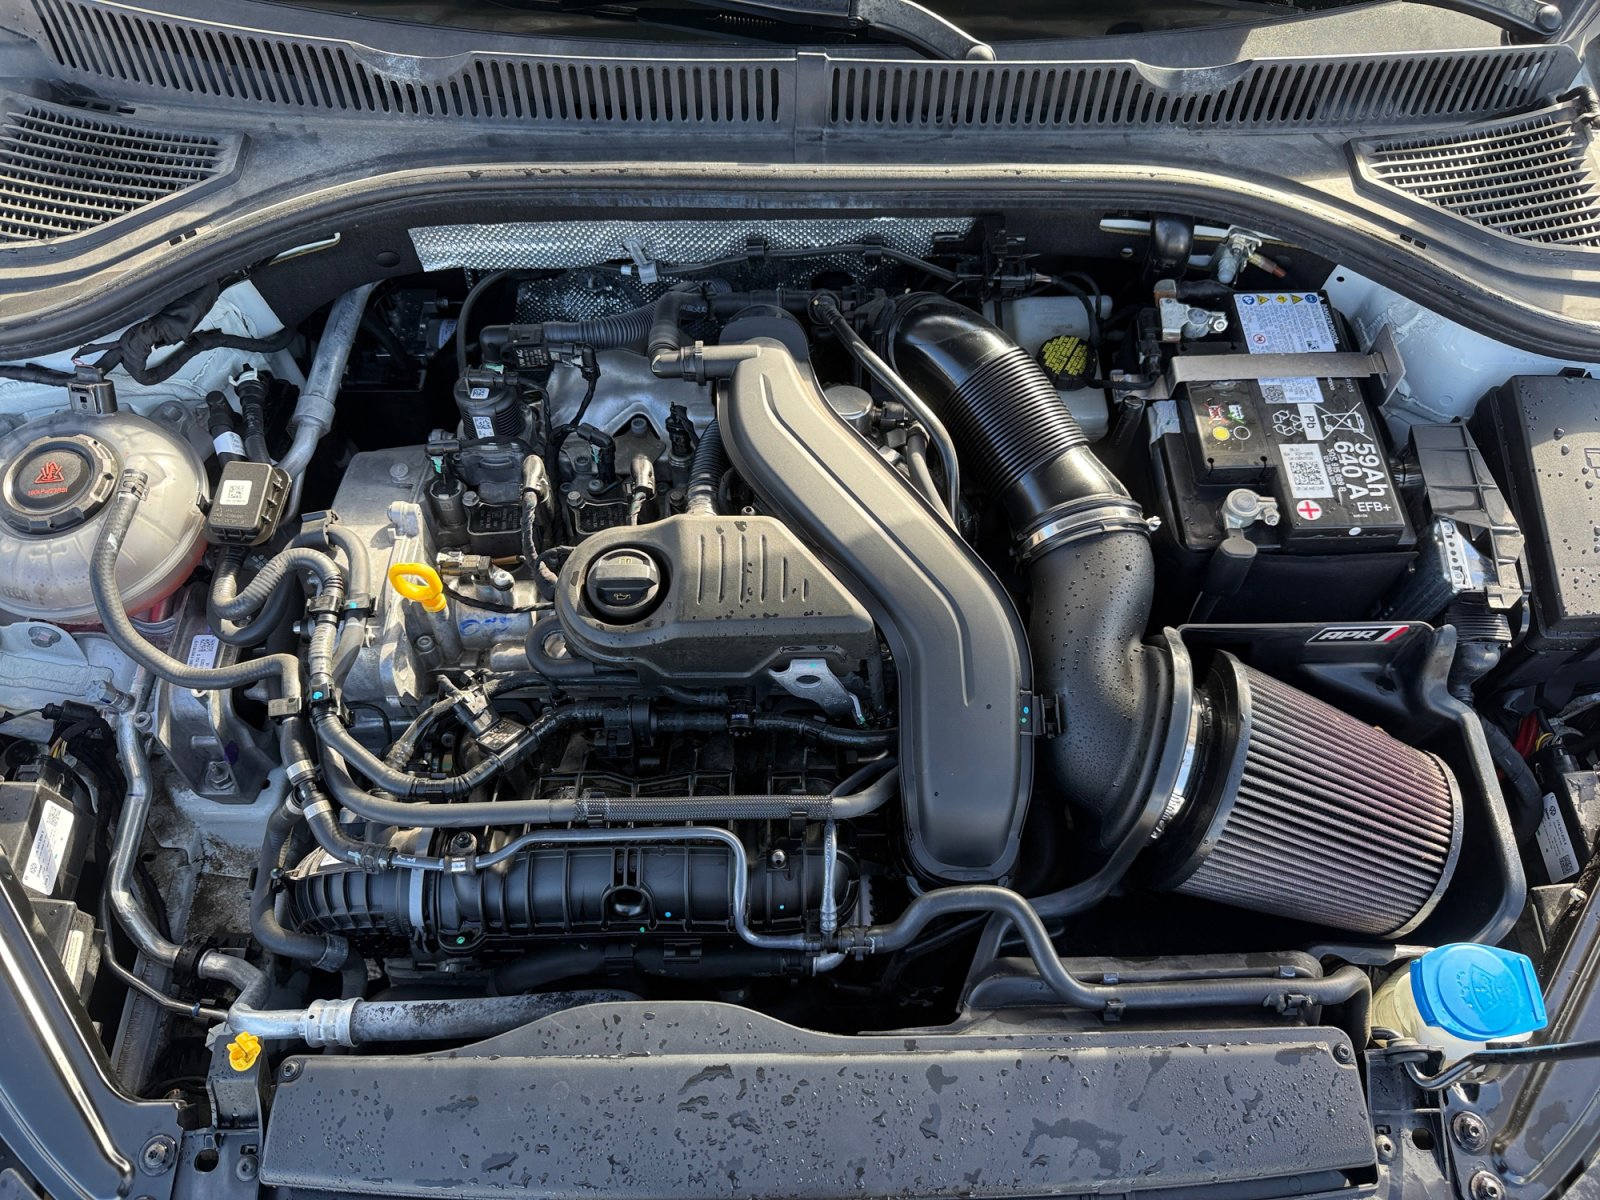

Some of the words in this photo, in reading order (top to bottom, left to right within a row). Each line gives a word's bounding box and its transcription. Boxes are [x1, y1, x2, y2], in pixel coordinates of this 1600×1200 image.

[1303, 415, 1317, 429] Pb
[1333, 441, 1363, 478] 640
[1354, 442, 1388, 497] 59Ah
[1345, 483, 1370, 500] A
[1356, 501, 1392, 512] EFB+
[1317, 630, 1379, 640] APR
